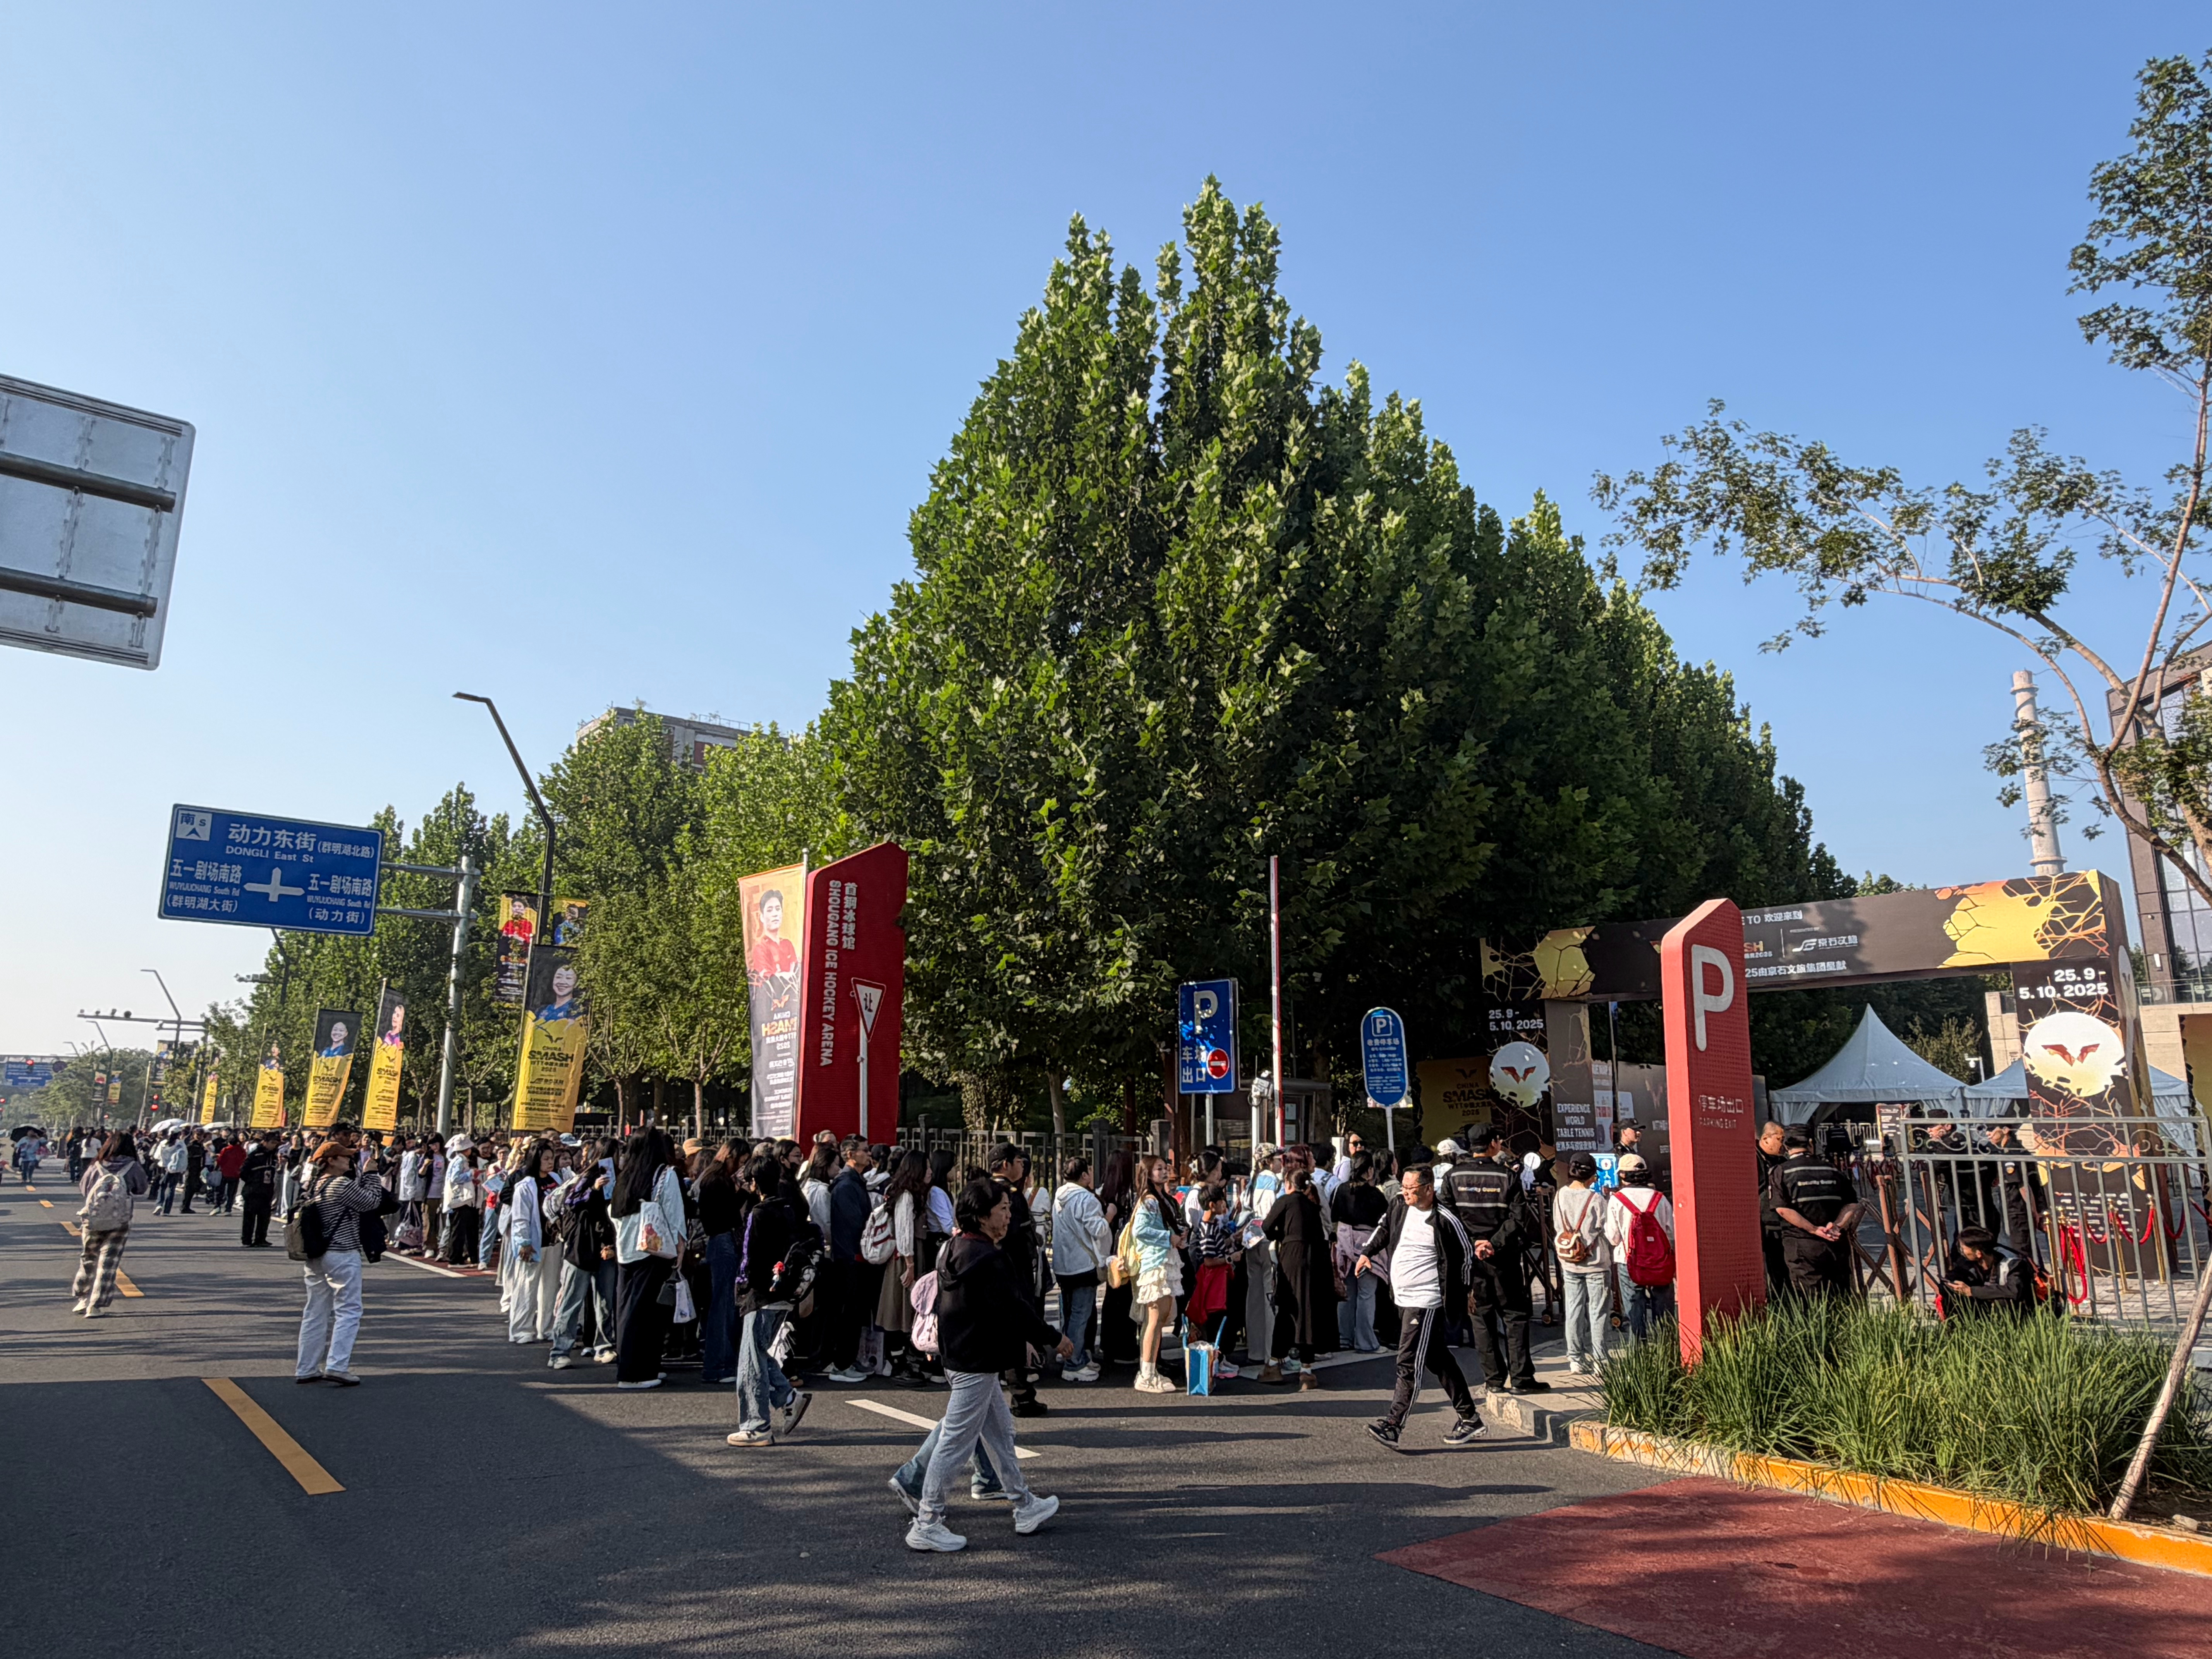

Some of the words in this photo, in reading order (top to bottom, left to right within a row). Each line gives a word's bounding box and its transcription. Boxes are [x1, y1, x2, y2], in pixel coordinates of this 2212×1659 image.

[180, 813, 196, 826] 南
[228, 823, 316, 851] 动力东街
[226, 845, 269, 858] DONGLI
[274, 851, 297, 861] East
[302, 854, 314, 863] St
[170, 859, 242, 884] 五一剧场南路
[214, 886, 230, 895] South
[308, 874, 372, 897] 五一剧场南路
[347, 899, 362, 908] South
[309, 907, 365, 924] (动力街)
[826, 880, 842, 946] SHOUGANG
[1747, 915, 1761, 925] TO
[825, 950, 838, 969] ICE
[822, 972, 837, 1021] HOCKEY
[1691, 944, 1735, 1052] P
[1194, 990, 1218, 1034] P
[1376, 1018, 1387, 1034] P
[820, 1023, 834, 1066] ARENA
[527, 1050, 574, 1062] SMASH
[1182, 1066, 1206, 1083] 出口
